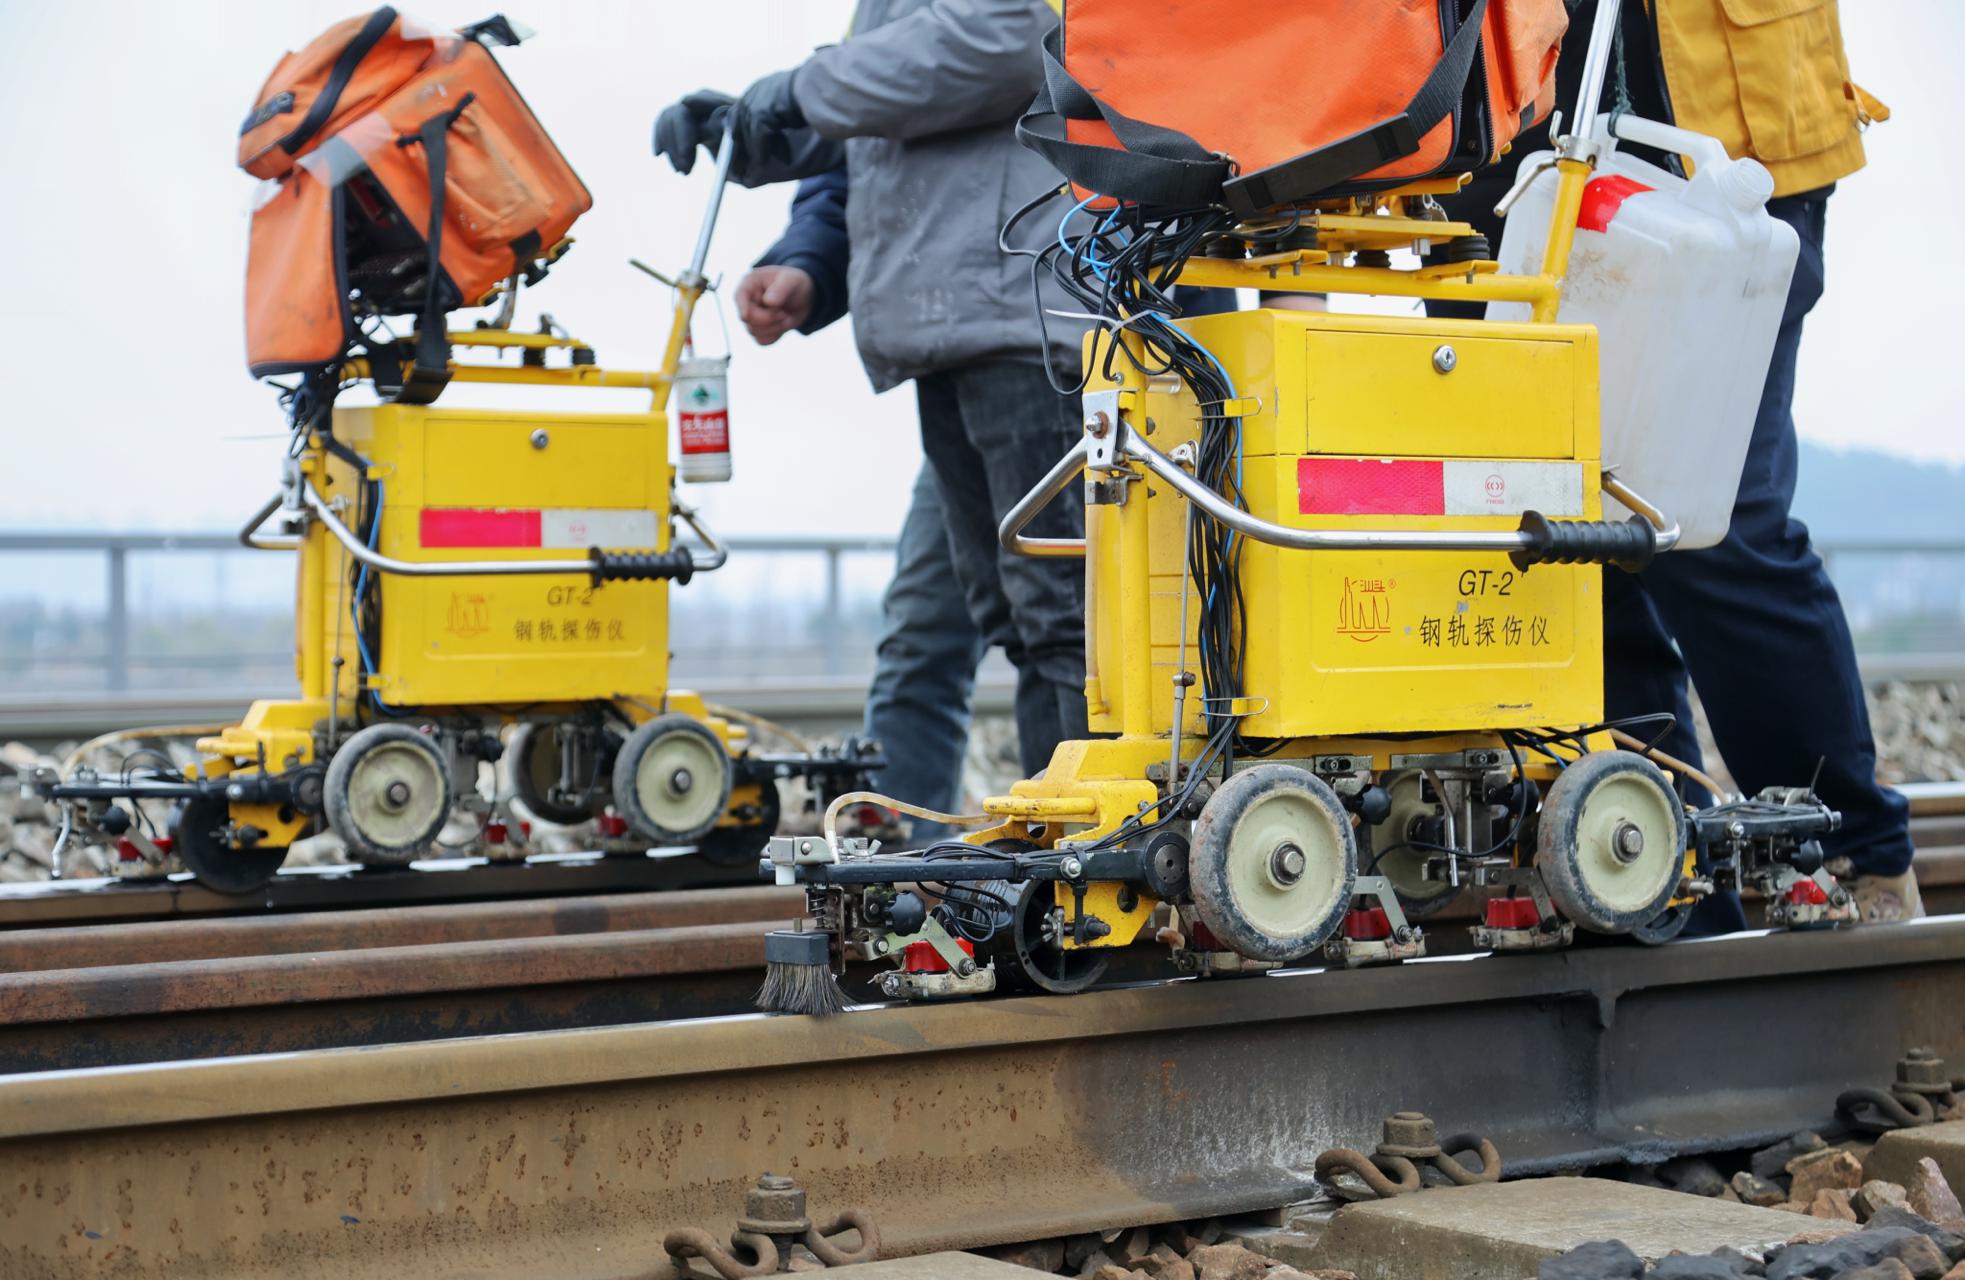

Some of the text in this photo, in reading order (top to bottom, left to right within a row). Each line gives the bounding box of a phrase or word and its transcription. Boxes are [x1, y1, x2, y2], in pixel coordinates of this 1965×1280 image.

[1458, 569, 1525, 596] GT-2
[513, 617, 625, 642] 钢轨探伤仪
[1419, 614, 1550, 648] 钢轨探伤仪
